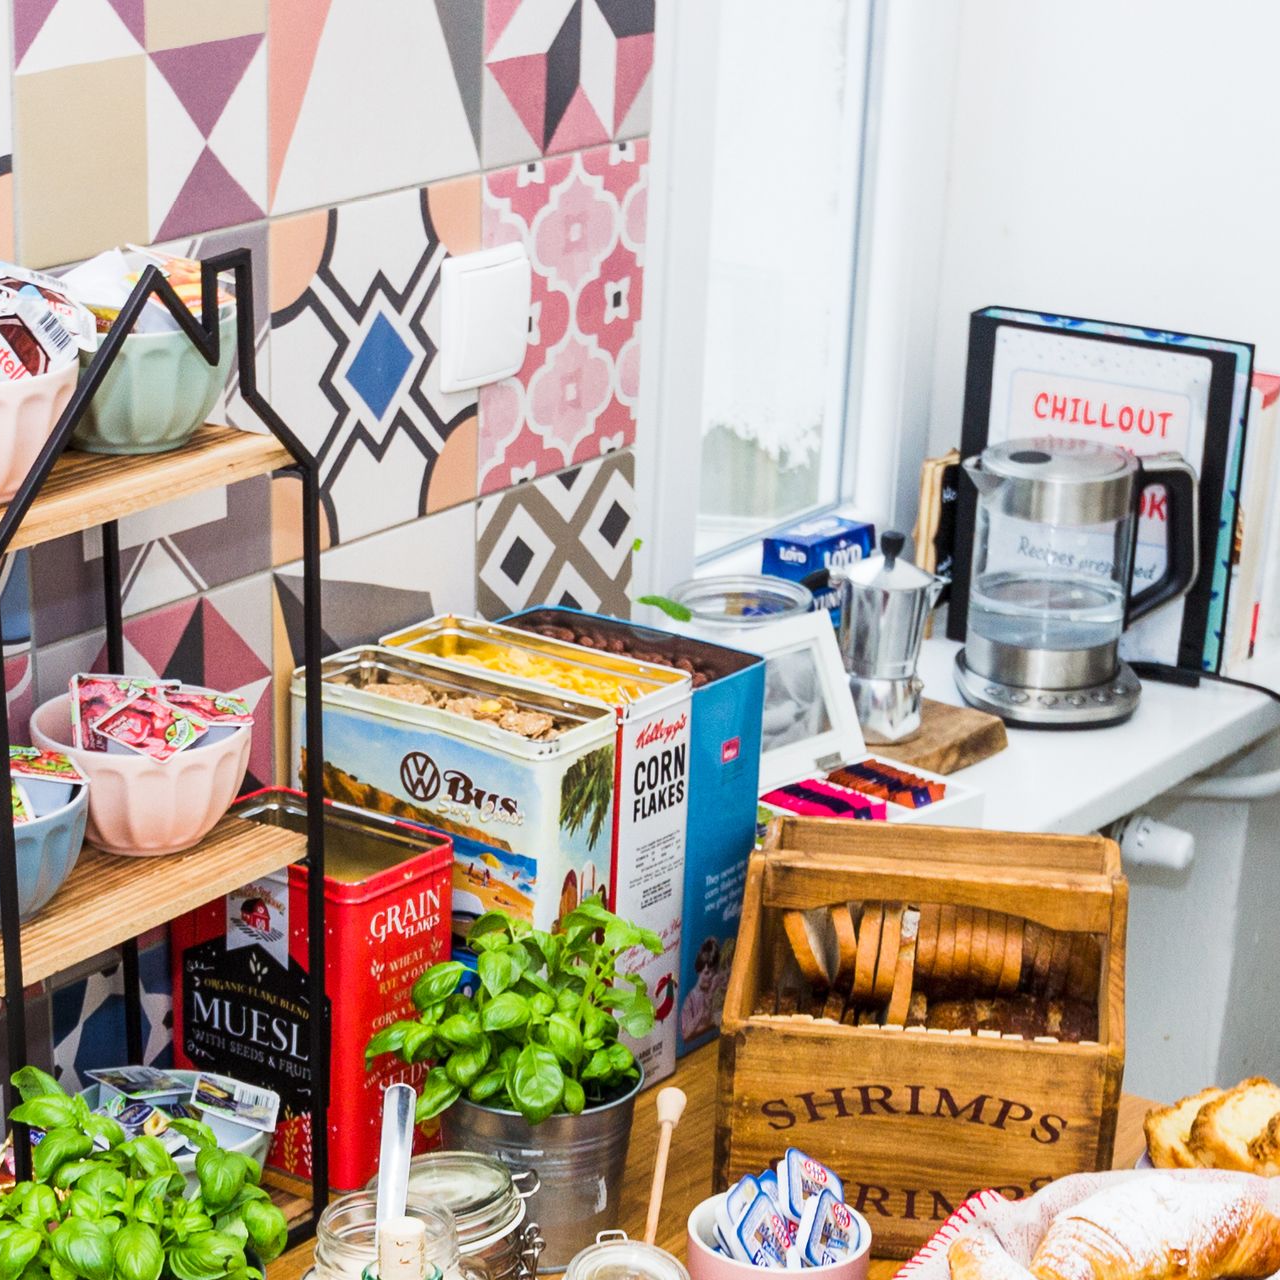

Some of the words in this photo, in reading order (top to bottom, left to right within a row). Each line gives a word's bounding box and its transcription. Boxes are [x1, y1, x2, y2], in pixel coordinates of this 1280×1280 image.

[1033, 392, 1173, 437] CHILLOUT
[635, 713, 687, 749] Kellogg's
[634, 743, 686, 796] CORN
[443, 770, 519, 816] Bus
[633, 780, 685, 823] FLAKES
[370, 885, 441, 943] GRAIN
[405, 913, 440, 939] FLAKES
[389, 948, 424, 972] WHEAT
[203, 978, 247, 993] ORGANIC
[249, 986, 277, 1005] FLAKE
[280, 999, 310, 1020] BLEND
[379, 977, 398, 994] RYE
[192, 990, 309, 1061] MUESL
[372, 1010, 398, 1029] CORN
[192, 1028, 226, 1049] WITH
[230, 1041, 264, 1063] SEEDS
[761, 1084, 1069, 1145] SHRIMPS
